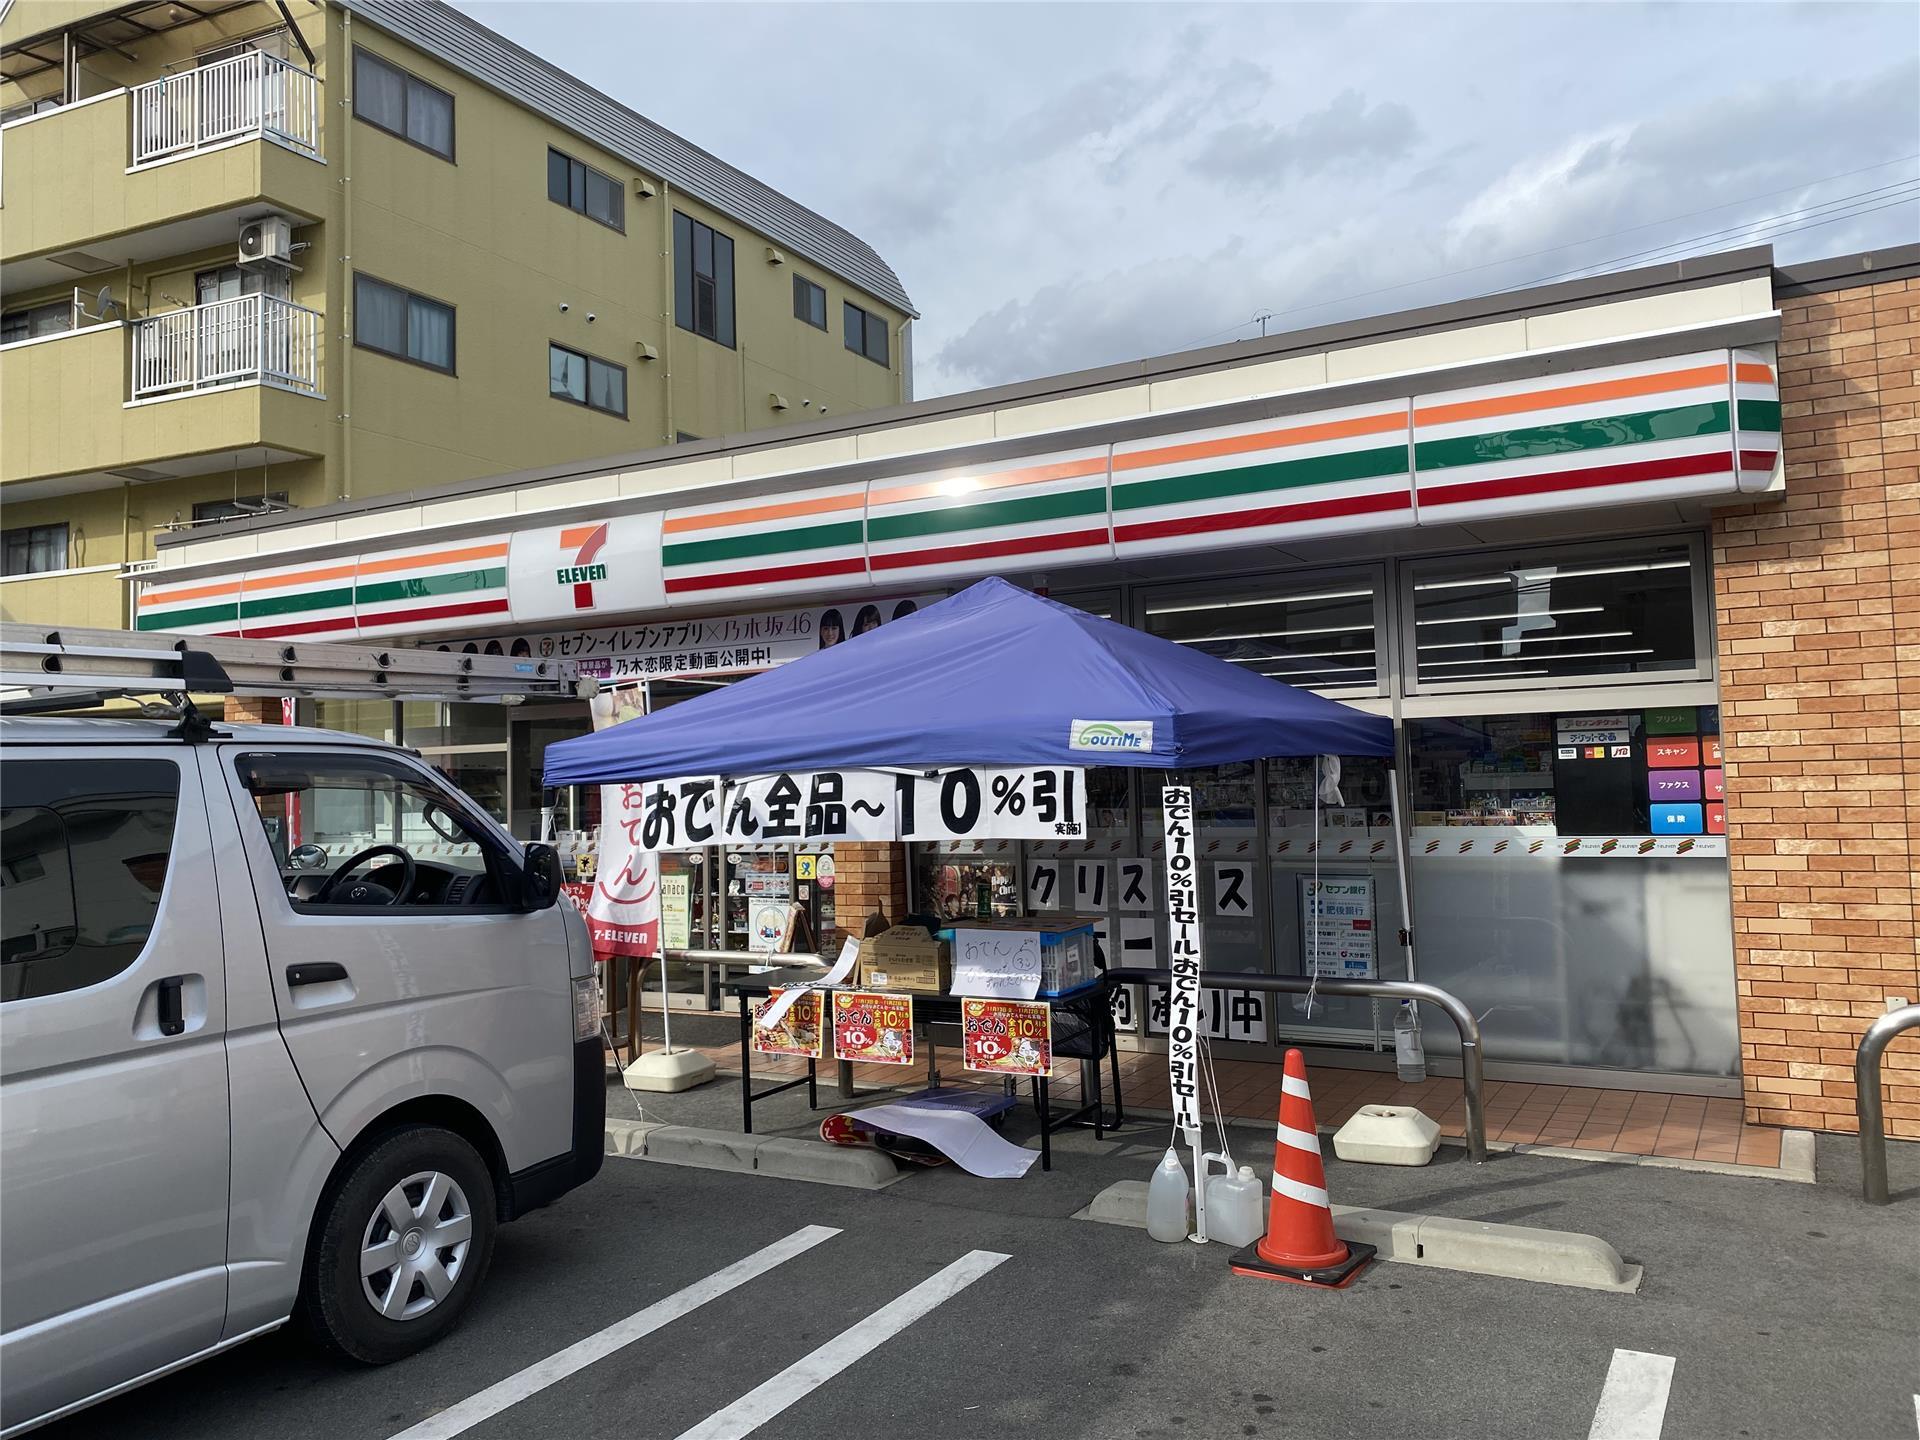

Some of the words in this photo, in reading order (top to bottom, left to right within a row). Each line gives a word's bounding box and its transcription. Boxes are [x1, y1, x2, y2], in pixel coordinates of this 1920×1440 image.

[615, 646, 772, 676] 乃木恋限定動画公開中!
[1655, 714, 1686, 724] プリント
[1657, 748, 1688, 756] スキャン
[1658, 781, 1690, 789] ファクス
[1666, 814, 1686, 824] 保険
[1326, 885, 1366, 895] セブン銀行
[837, 1010, 872, 1025] おでん
[966, 1018, 1006, 1034] おでん
[1008, 1018, 1016, 1037] 全品
[843, 1031, 873, 1045] 10%
[974, 1040, 1007, 1055] 10%
